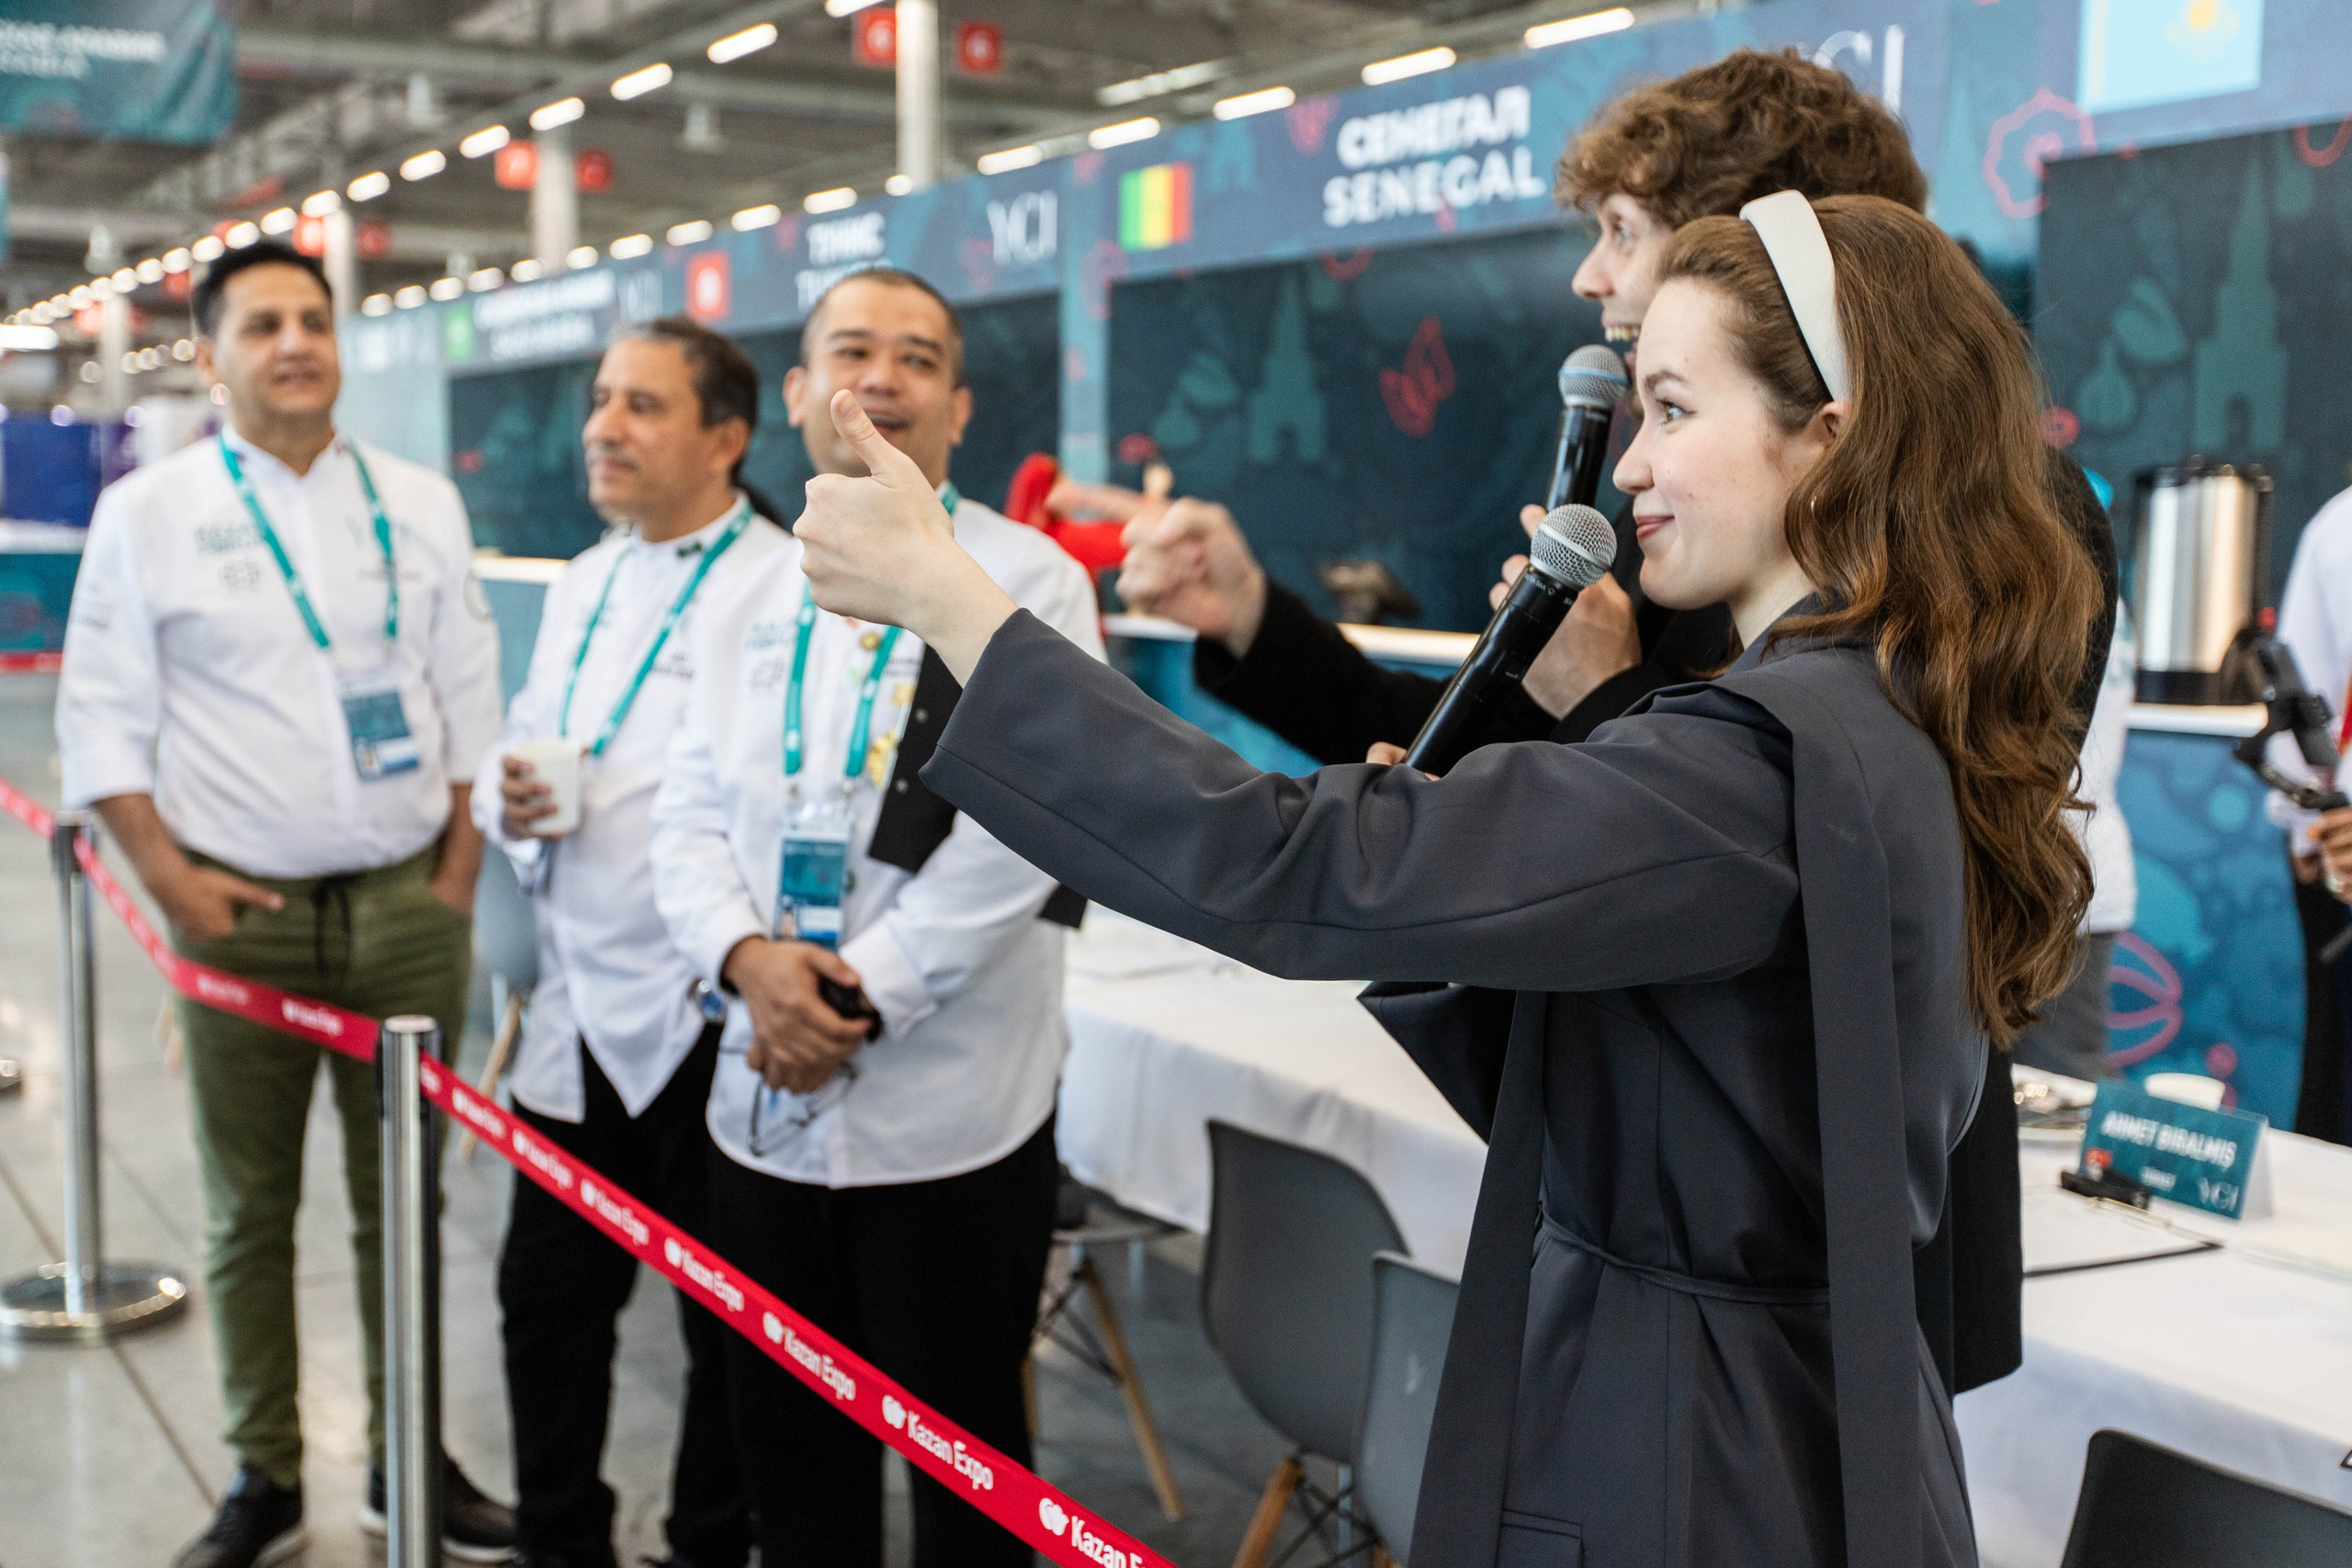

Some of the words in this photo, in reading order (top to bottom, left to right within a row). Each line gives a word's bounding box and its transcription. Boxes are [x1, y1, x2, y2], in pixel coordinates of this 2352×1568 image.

[1337, 85, 1530, 169] СЕНЕГАЛ
[1323, 145, 1547, 228] SENEGAL
[682, 1249, 715, 1293] Kazan
[714, 1270, 744, 1312] Expo
[784, 1326, 822, 1377] Kazan
[821, 1354, 855, 1401] Expo
[908, 1411, 953, 1464] Kazan
[954, 1440, 993, 1490] Expo
[1071, 1516, 1127, 1568] Kazan
